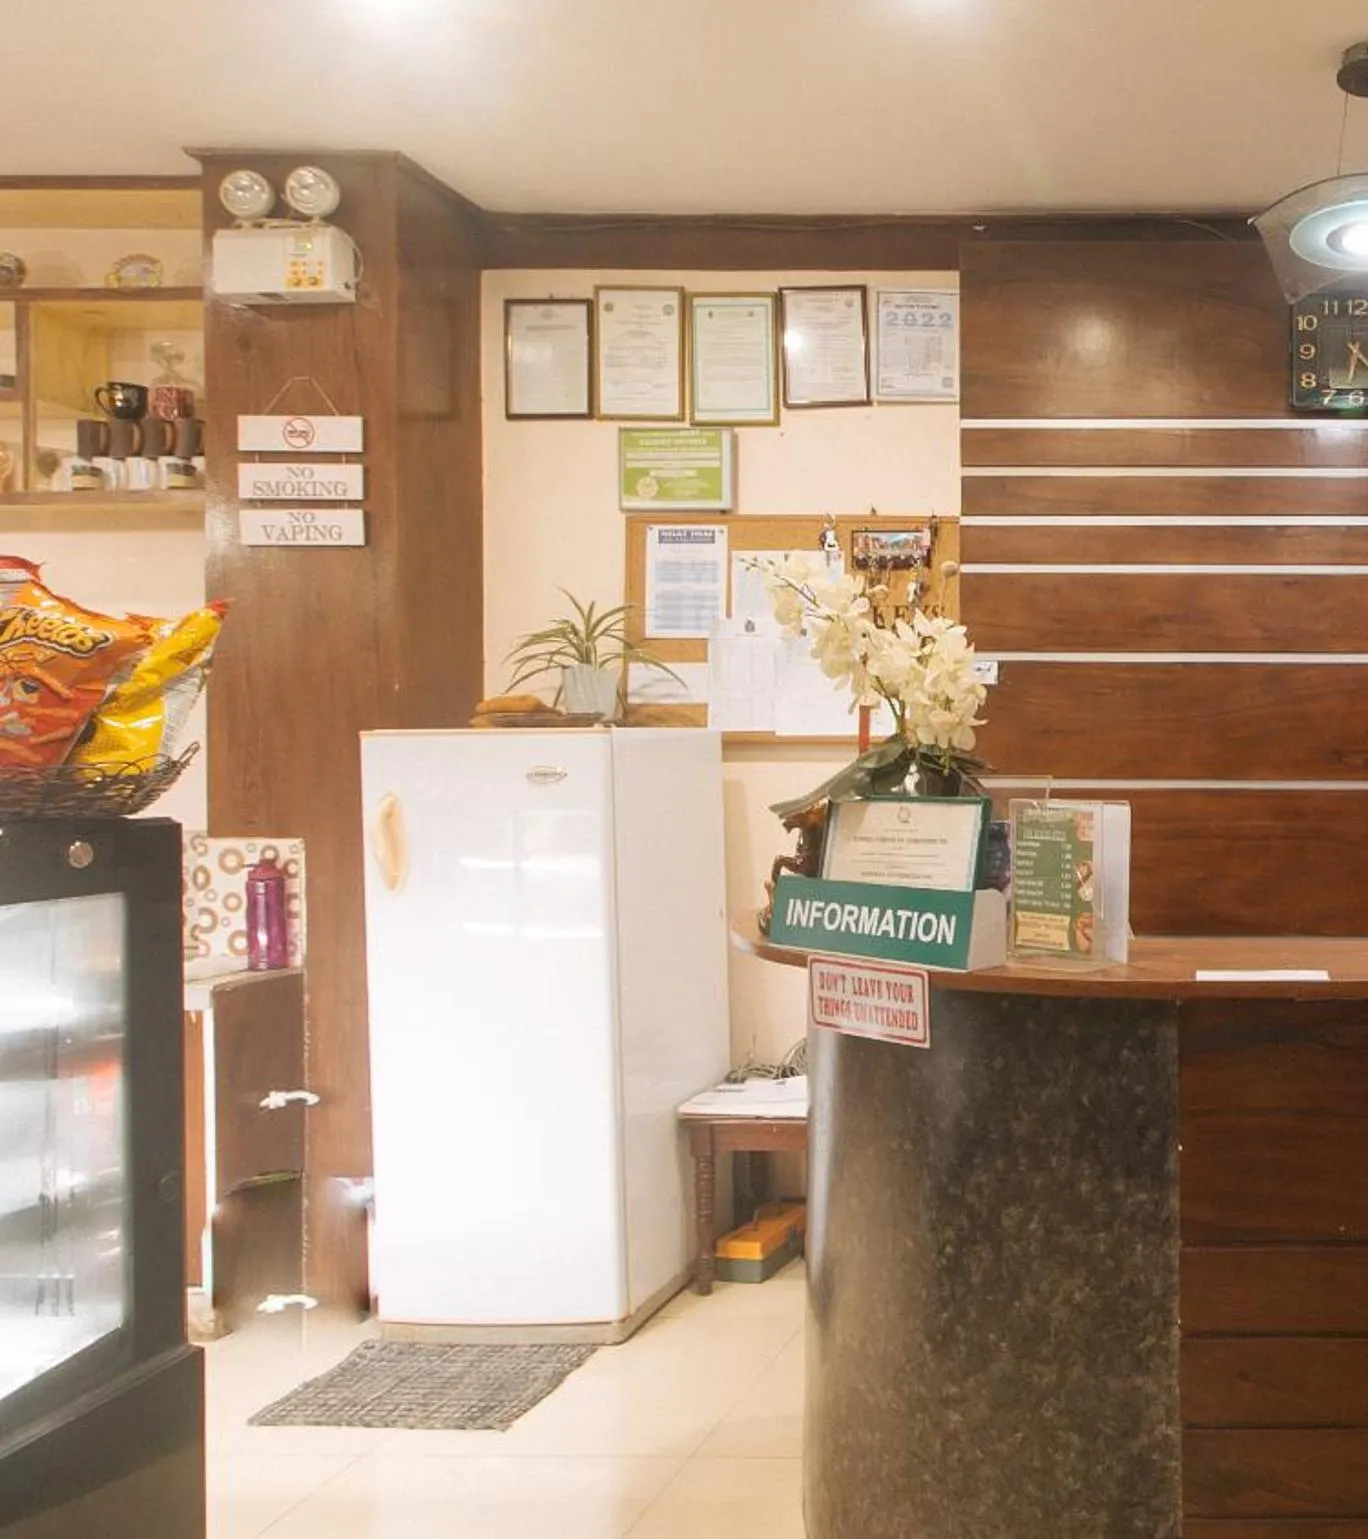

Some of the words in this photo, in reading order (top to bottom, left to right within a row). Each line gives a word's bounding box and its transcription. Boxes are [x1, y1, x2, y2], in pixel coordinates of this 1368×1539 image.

[1322, 300, 1338, 316] 11
[1345, 299, 1368, 316] 12
[885, 311, 953, 328] 2022
[1296, 314, 1318, 331] 10
[1299, 343, 1316, 360] 9
[1300, 371, 1316, 389] 8
[1322, 389, 1338, 405] 7
[1349, 390, 1365, 407] 6
[285, 466, 315, 480] NO
[252, 481, 348, 497] SMOKING
[286, 511, 316, 524] NO
[260, 525, 343, 541] VAPING
[786, 898, 957, 946] INFORMATION
[852, 976, 883, 1000] LEAVE
[886, 981, 915, 1004] YOUR
[818, 995, 851, 1019] THINGS
[853, 1001, 919, 1031] UNATTENDED
